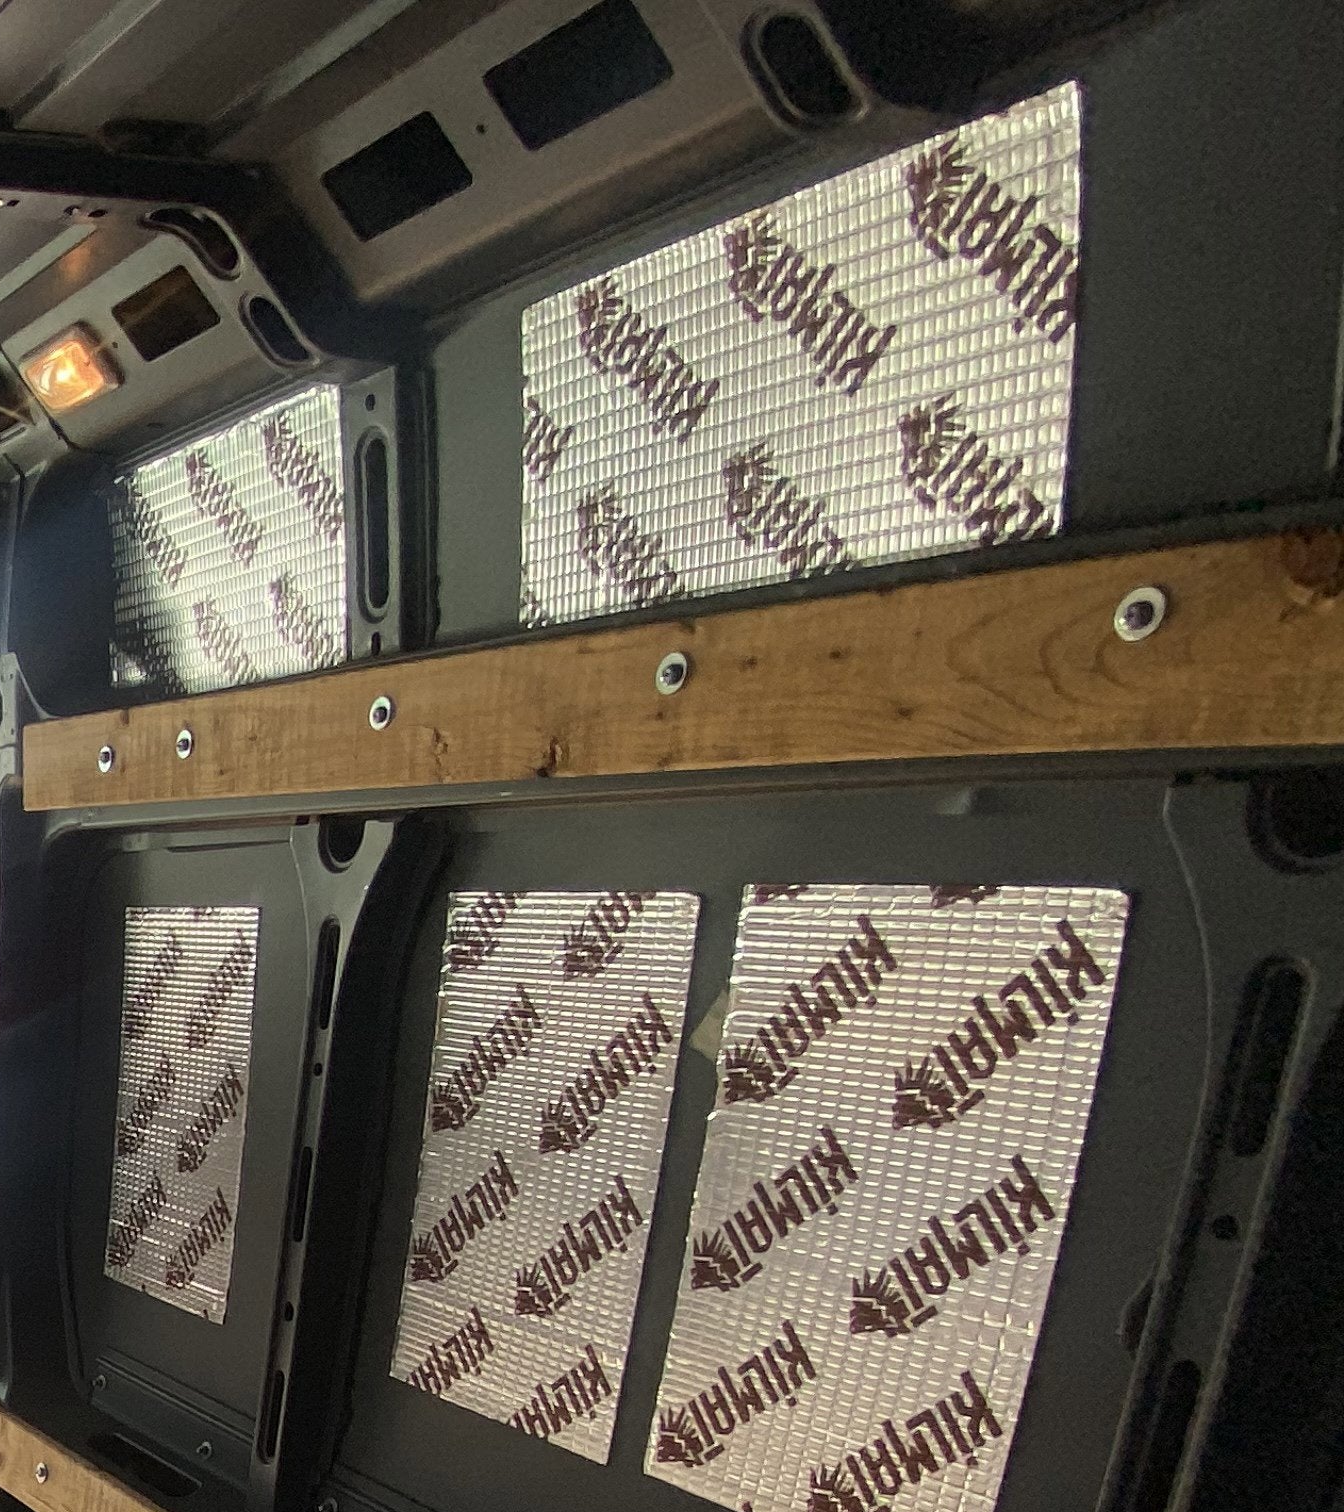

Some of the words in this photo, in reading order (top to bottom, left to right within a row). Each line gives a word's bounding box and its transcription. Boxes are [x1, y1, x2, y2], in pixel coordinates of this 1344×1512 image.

[743, 246, 897, 397] KILMAT
[451, 983, 542, 1121] KILMAT
[561, 994, 672, 1141] KILMAT
[757, 913, 898, 1091] KILMAT
[933, 919, 1107, 1116] KILMAT
[179, 1187, 232, 1280] KILMAT
[434, 1149, 520, 1277] KILMAT
[540, 1175, 643, 1308] KILMAT
[723, 1124, 861, 1284] KILMAT
[889, 1154, 1056, 1326] KILMAT
[687, 1319, 819, 1462] KILMAT
